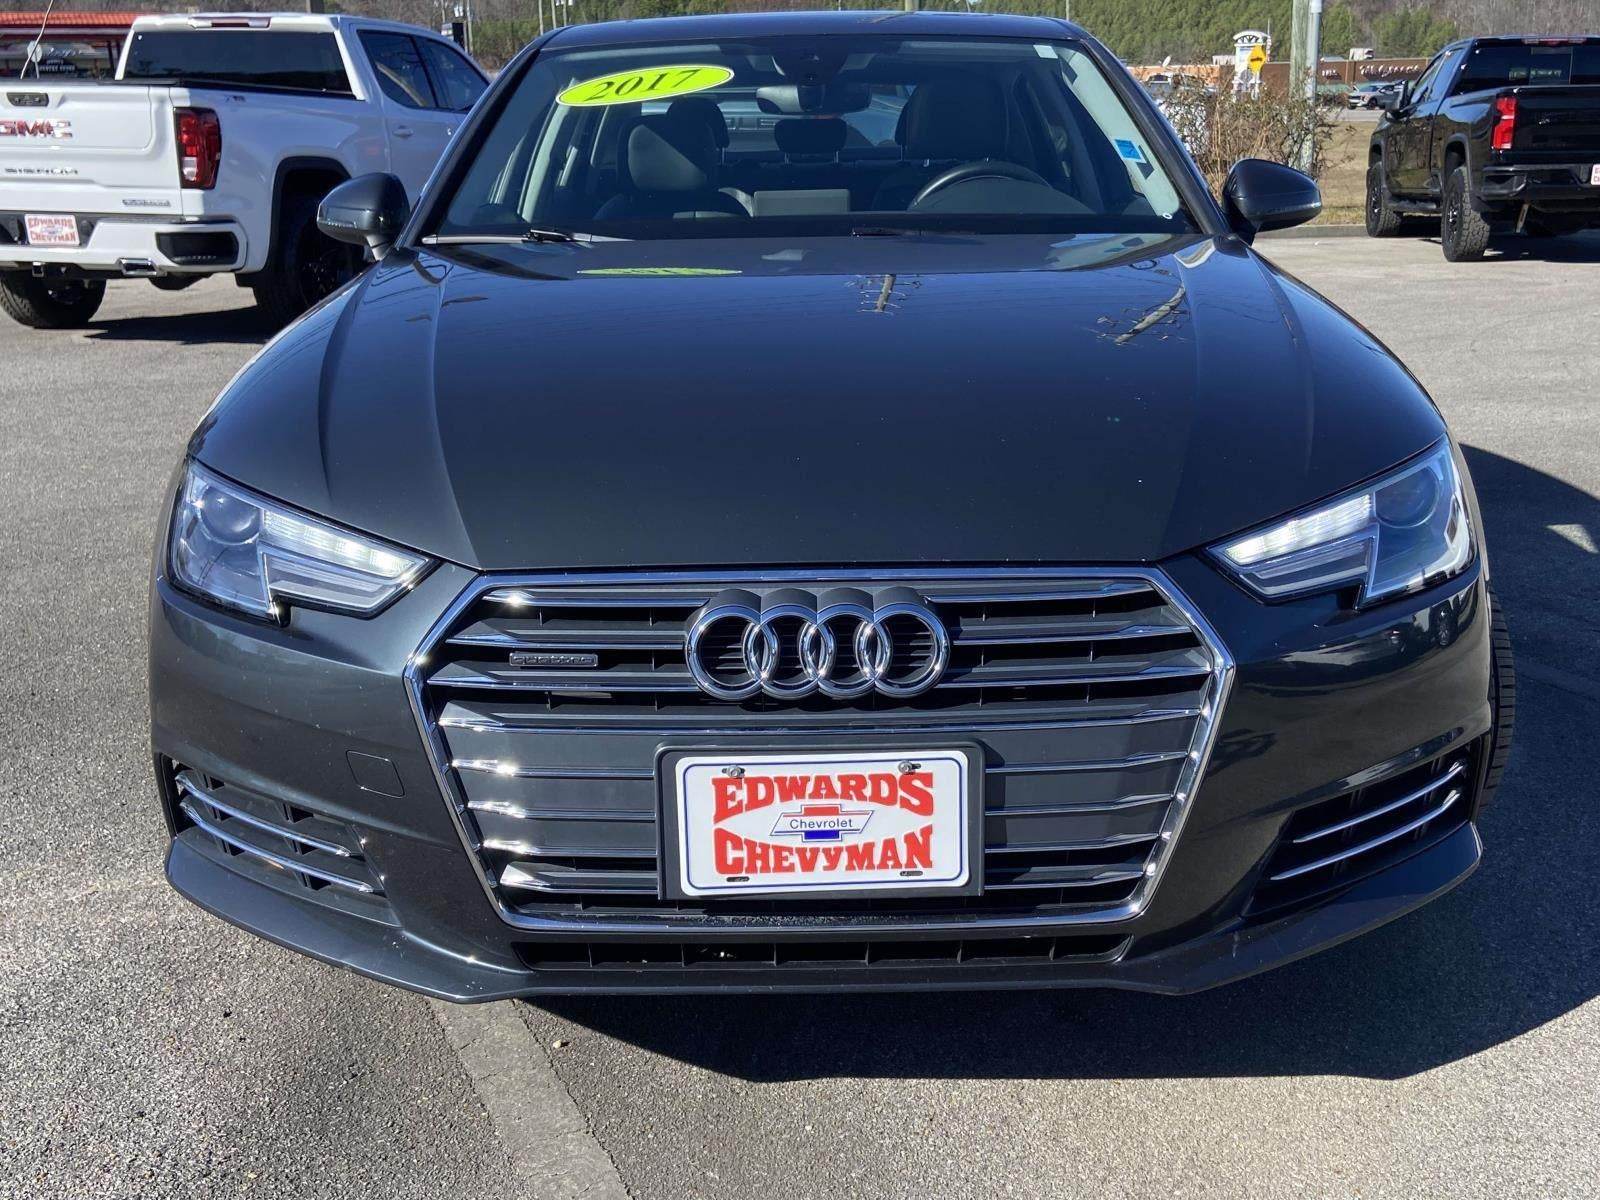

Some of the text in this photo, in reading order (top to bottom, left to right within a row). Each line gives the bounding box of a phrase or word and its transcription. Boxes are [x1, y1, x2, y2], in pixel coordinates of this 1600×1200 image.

[584, 69, 701, 102] 2017
[0, 119, 72, 138] GMC
[28, 217, 73, 229] EDWARDS
[711, 772, 934, 826] EDWARDS
[789, 817, 853, 830] Chevrolet
[713, 824, 934, 875] CHEVYMAN
